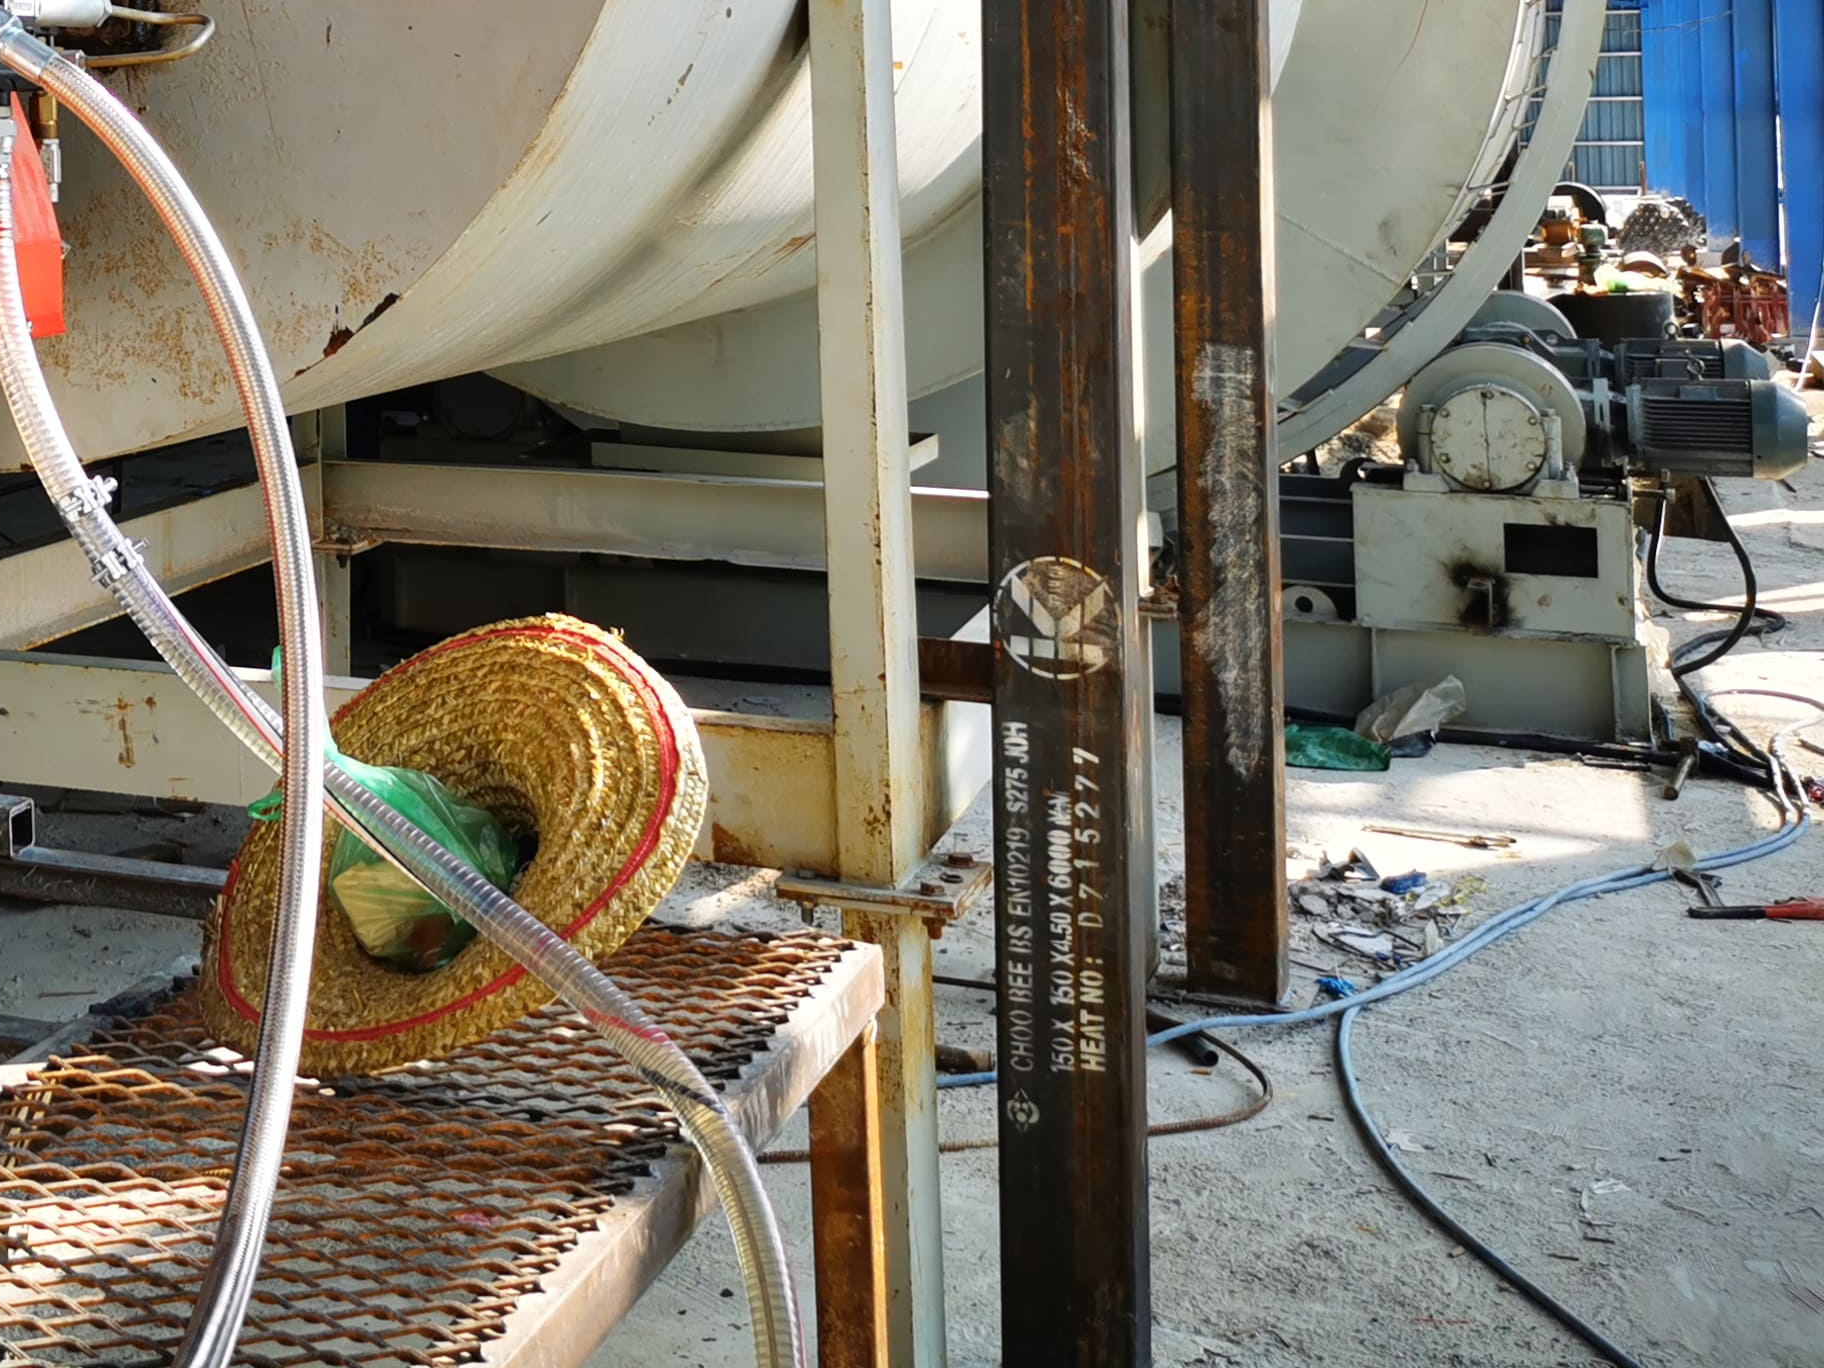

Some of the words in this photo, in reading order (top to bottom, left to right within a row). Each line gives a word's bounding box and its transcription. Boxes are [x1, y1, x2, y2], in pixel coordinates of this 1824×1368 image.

[1005, 767, 1029, 814] S275
[1006, 827, 1031, 917] EN10219
[1047, 829, 1072, 889] 6000
[1049, 892, 1073, 908] X
[1007, 923, 1032, 954] BS
[1008, 959, 1032, 1003] BEE
[1050, 971, 1073, 1006] 150
[1010, 1009, 1033, 1072] CHOO
[1052, 1018, 1074, 1034] X
[1080, 1009, 1106, 1072] HEAT
[1050, 1037, 1075, 1073] 150
